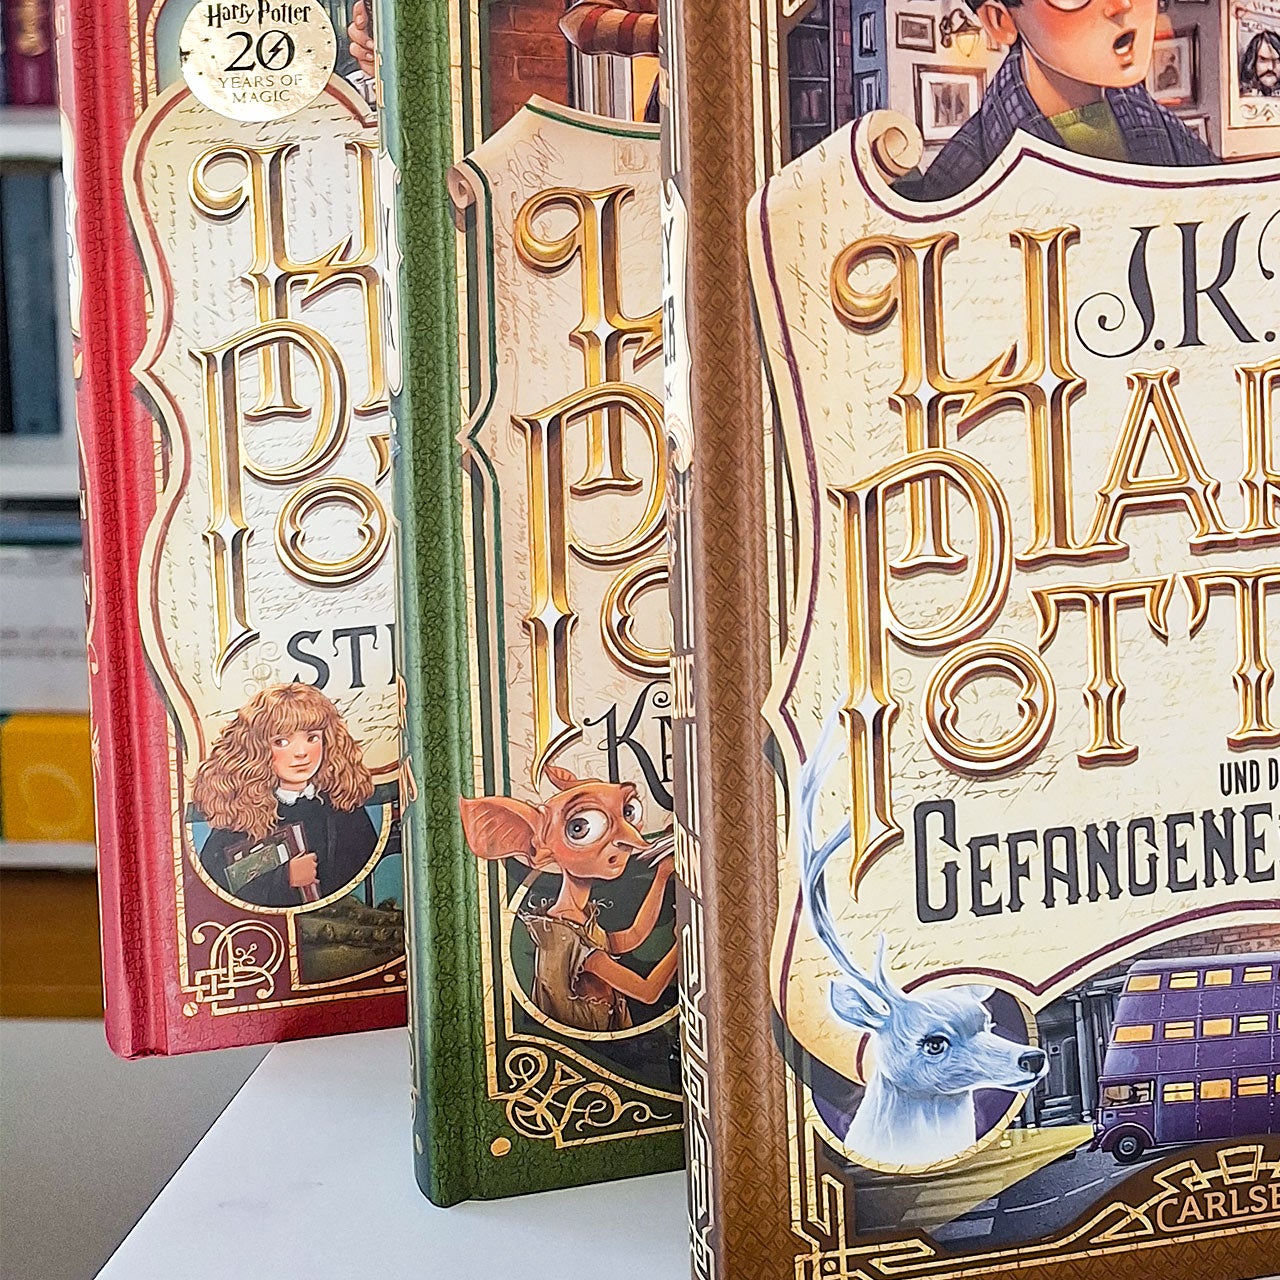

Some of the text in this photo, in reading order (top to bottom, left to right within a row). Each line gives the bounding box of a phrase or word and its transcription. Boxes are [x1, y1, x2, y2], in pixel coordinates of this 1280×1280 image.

[203, 2, 255, 29] Harry
[223, 29, 296, 72] 20
[217, 74, 303, 89] YEARS OF
[232, 89, 291, 104] MAGIC
[1219, 760, 1261, 798] UND
[912, 799, 1276, 924] GEFANGENE
